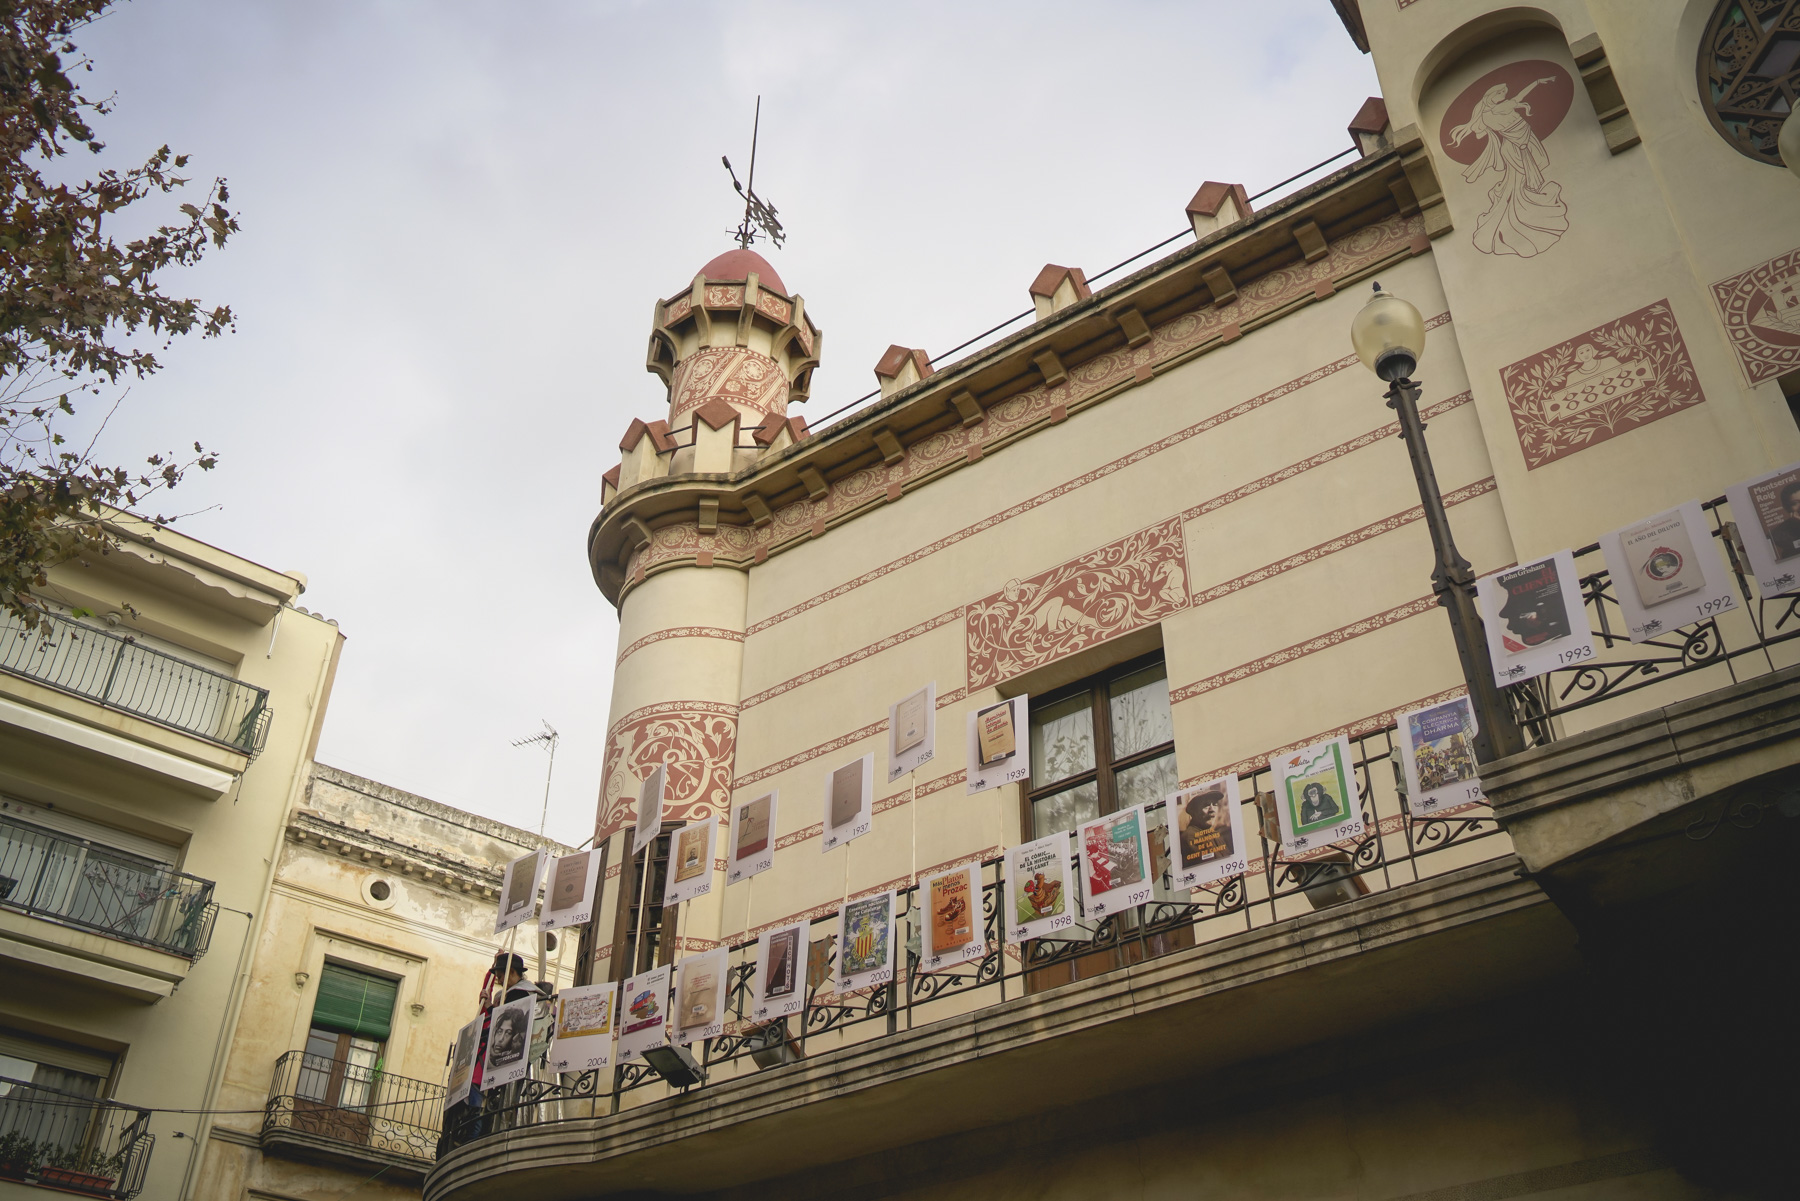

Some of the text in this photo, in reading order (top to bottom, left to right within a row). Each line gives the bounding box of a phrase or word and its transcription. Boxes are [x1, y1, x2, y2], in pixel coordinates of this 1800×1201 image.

[1753, 474, 1797, 494] Montserrat
[1756, 491, 1776, 503] Roig
[1635, 535, 1646, 544] AÑO
[1657, 521, 1681, 535] DILUVIO
[1502, 563, 1546, 583] John Grisham
[1540, 567, 1553, 578] EL
[1512, 576, 1557, 595] CLIENTE
[1696, 595, 1733, 616] 1992
[1558, 645, 1592, 664] 1993
[1421, 711, 1458, 725] COMPANYIA
[1424, 722, 1460, 736] DHARMA
[917, 749, 933, 764] 1938
[1006, 768, 1026, 781] 1939
[1466, 787, 1480, 799] 19
[852, 822, 869, 836] 1937
[1334, 822, 1361, 838] 1995
[1193, 833, 1221, 845] MALNOMS
[1186, 852, 1201, 861] GENT
[1209, 844, 1227, 854] CANET
[756, 858, 771, 871] 1936
[1034, 861, 1049, 870] CANET
[1220, 860, 1245, 875] 1996
[942, 873, 964, 886] Platón
[942, 881, 961, 890] menos
[694, 883, 710, 894] 1935
[942, 883, 968, 897] Prozac
[1128, 889, 1151, 904] 1997
[520, 910, 533, 921] 1932
[572, 913, 589, 922] 1933
[1050, 915, 1072, 929] 1998
[962, 945, 982, 958] 1999
[870, 969, 891, 983] 2000
[784, 1000, 801, 1012] 2001
[703, 1024, 721, 1036] 2002
[587, 1057, 608, 1067] 2004
[508, 1067, 525, 1080] 2005
